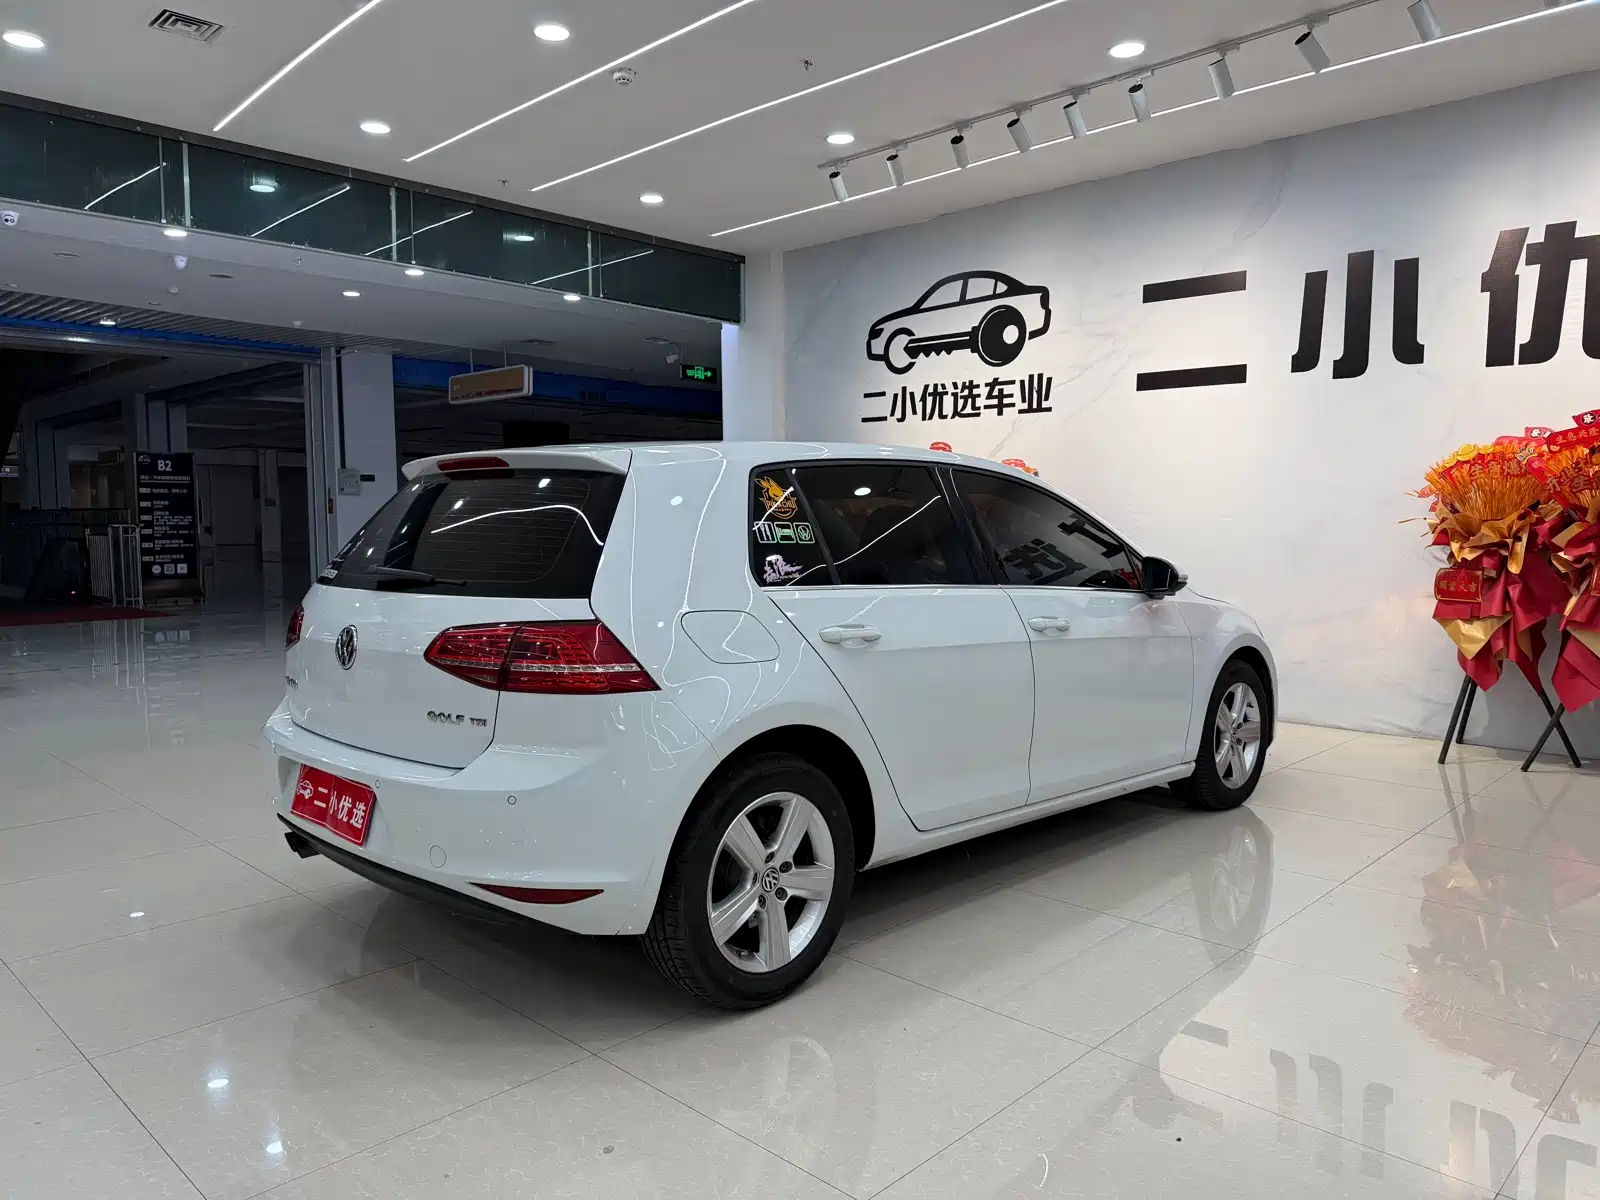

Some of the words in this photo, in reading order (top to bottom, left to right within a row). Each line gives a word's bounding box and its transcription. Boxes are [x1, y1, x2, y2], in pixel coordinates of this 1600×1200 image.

[861, 372, 1053, 423] 二小优选车业
[157, 459, 172, 472] B2
[426, 709, 465, 726] GOLF
[469, 717, 488, 728] TSI
[312, 785, 367, 829] 二小优选
